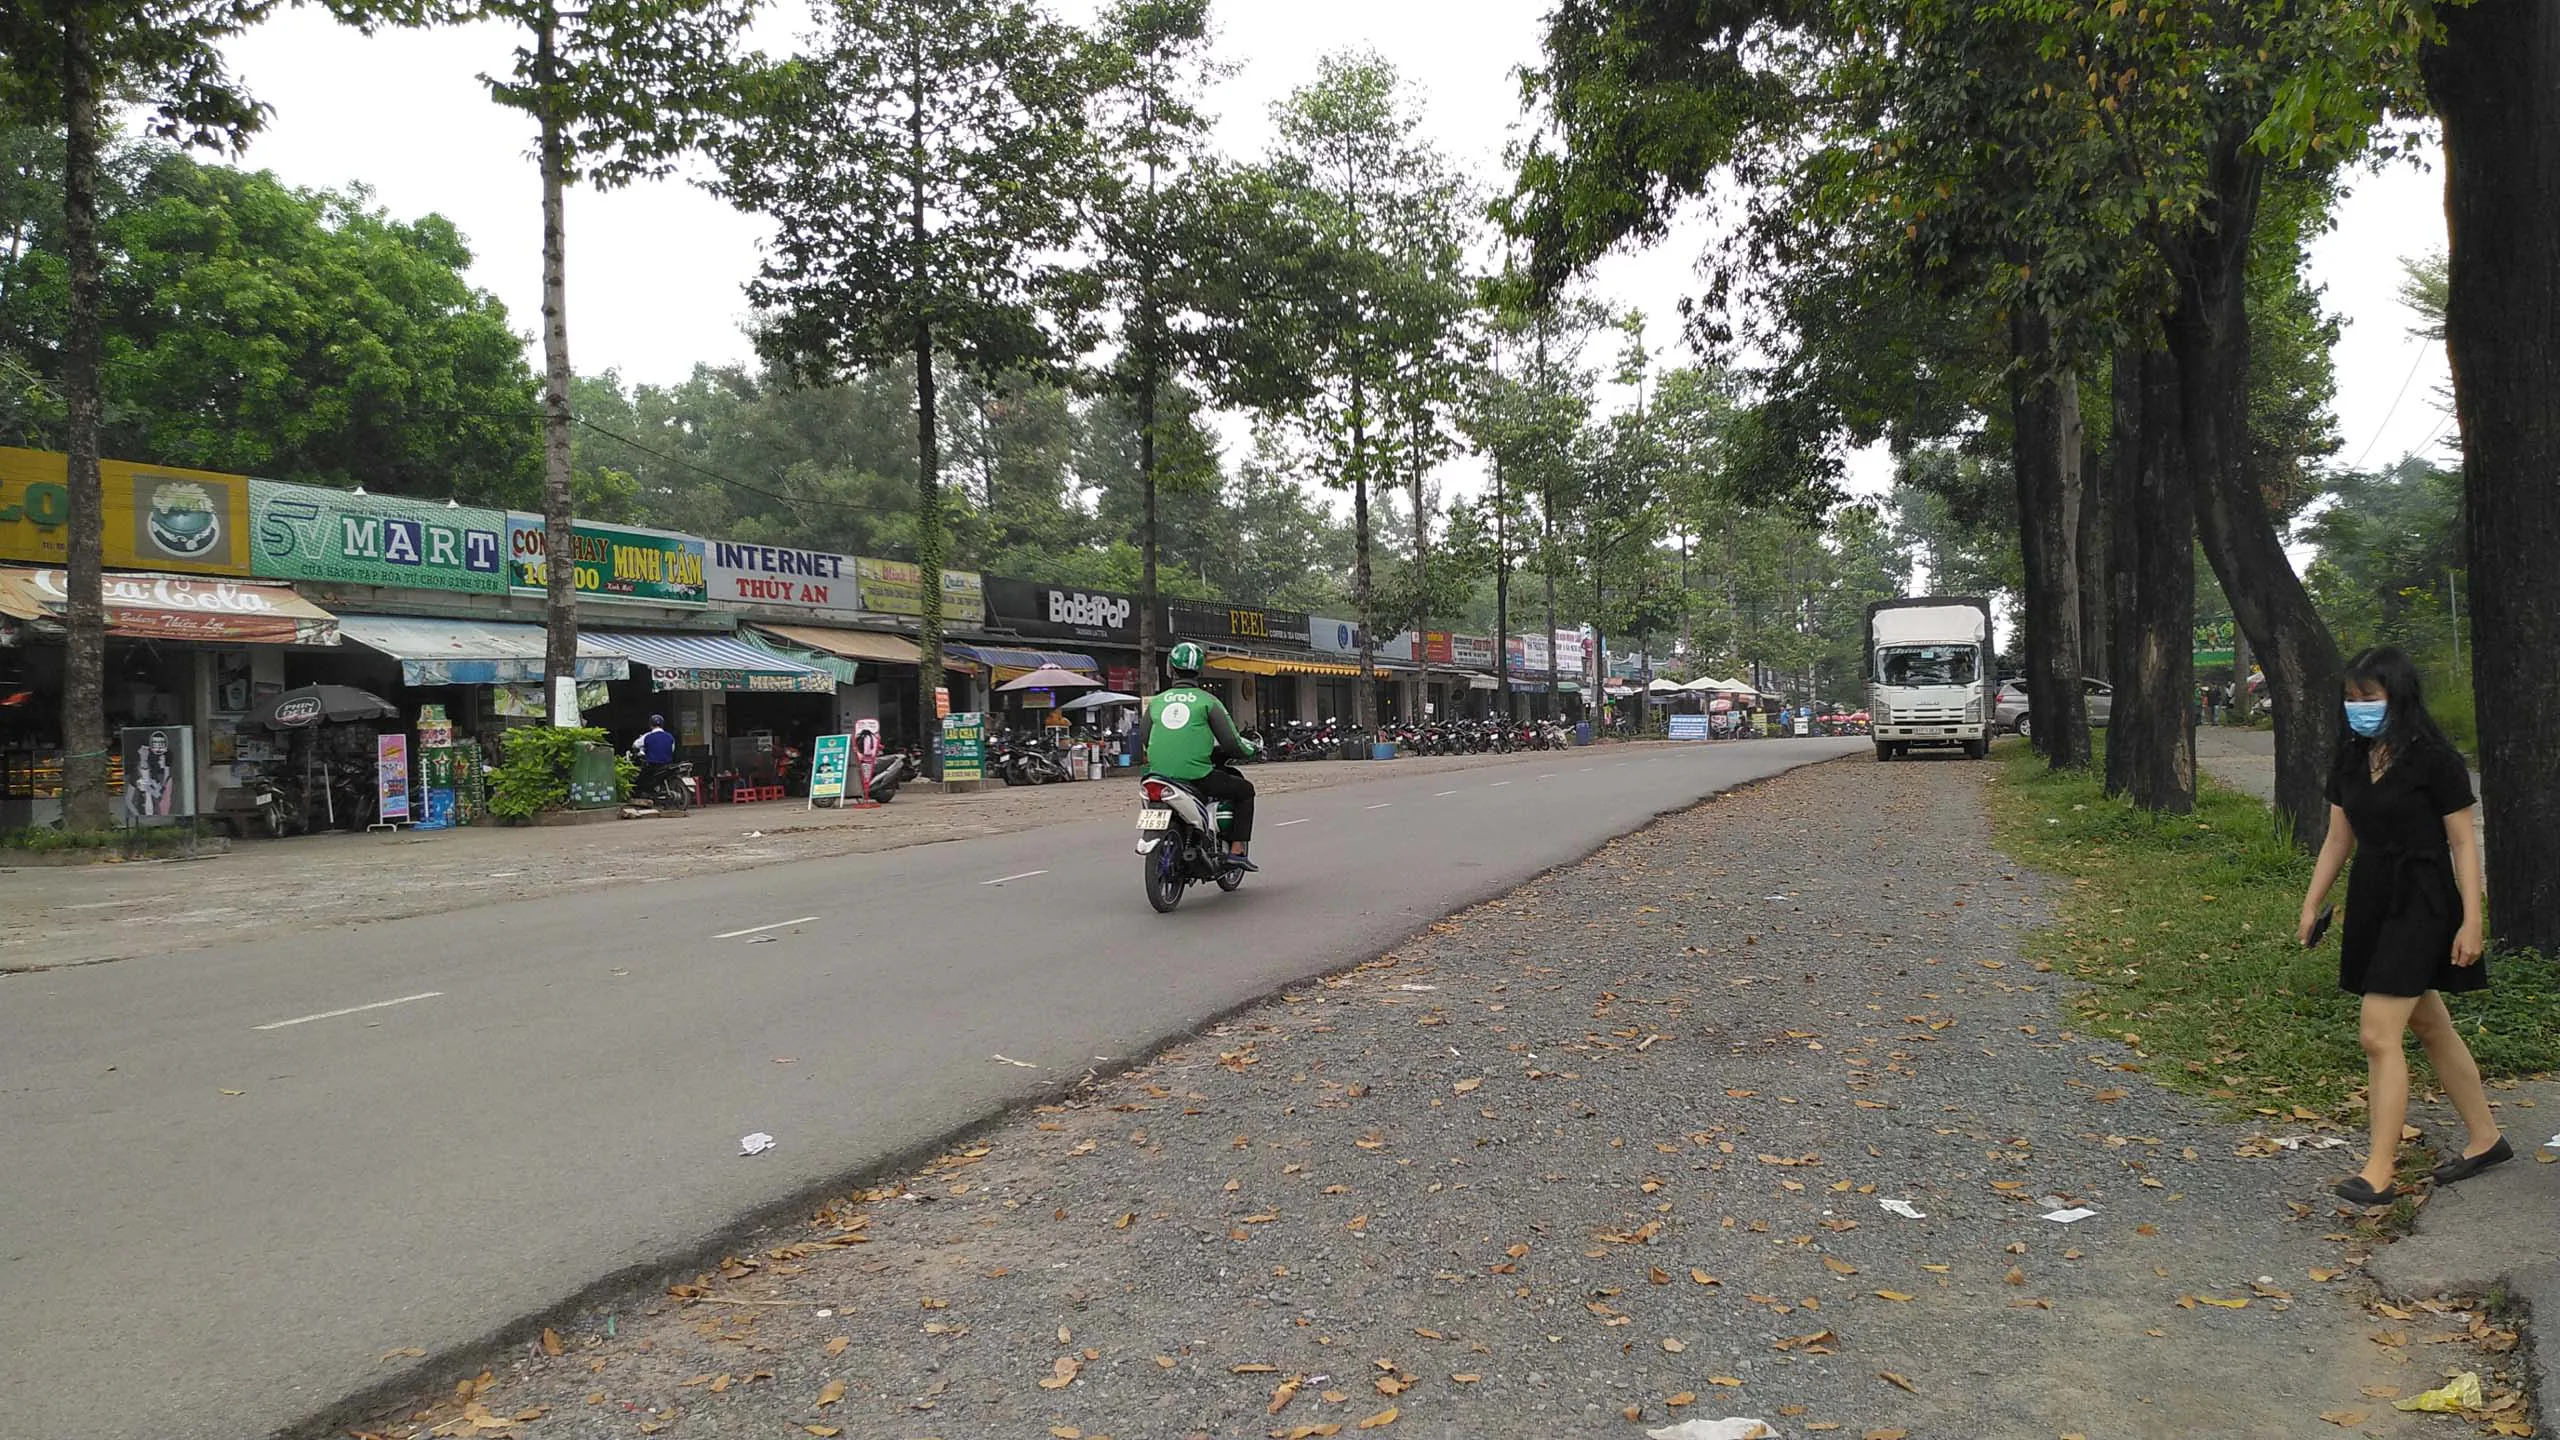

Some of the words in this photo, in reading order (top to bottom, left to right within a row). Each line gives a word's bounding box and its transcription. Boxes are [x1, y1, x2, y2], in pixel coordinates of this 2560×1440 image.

[342, 517, 496, 569] MART
[613, 544, 663, 583] MINH
[664, 542, 704, 587] TÂM
[715, 543, 843, 579] INTERNET
[736, 576, 794, 601] THÚY
[800, 586, 829, 603] AN
[1229, 609, 1268, 638] FEEL
[1163, 691, 1197, 703] Grab
